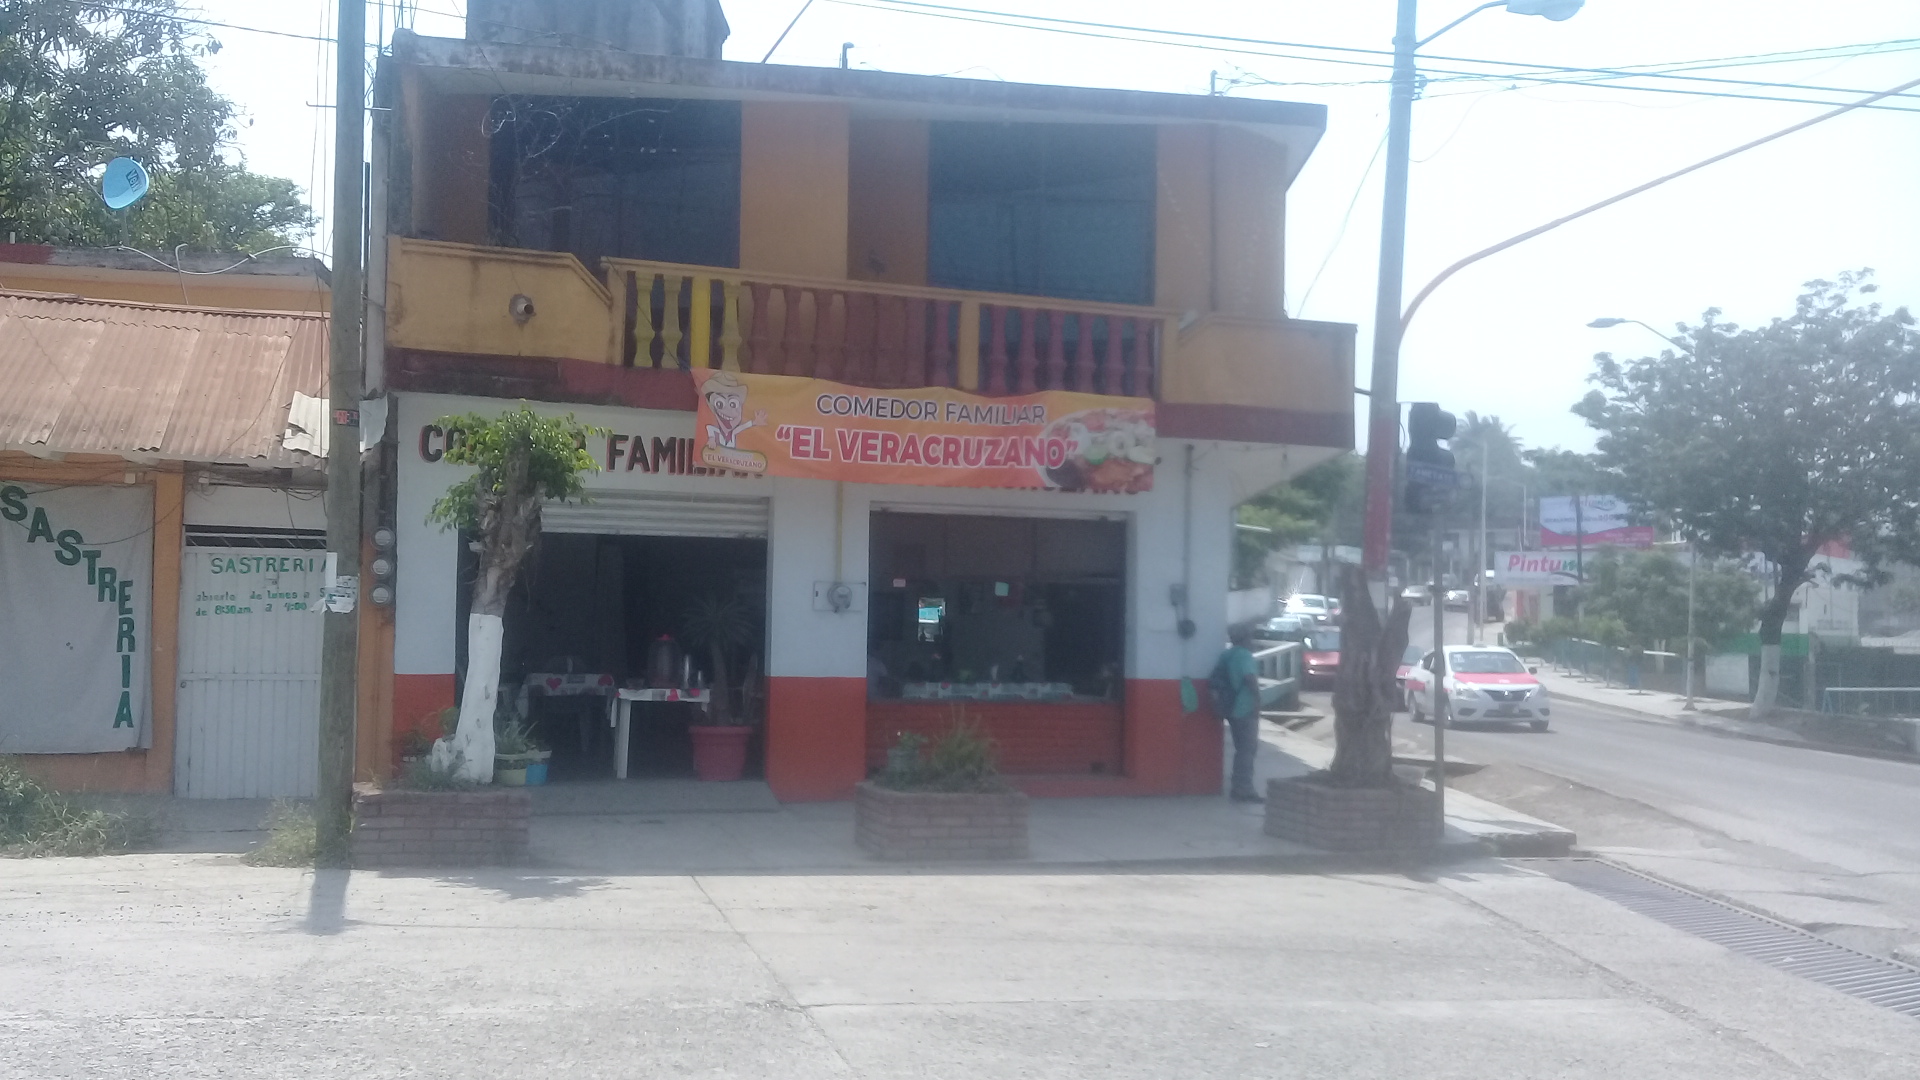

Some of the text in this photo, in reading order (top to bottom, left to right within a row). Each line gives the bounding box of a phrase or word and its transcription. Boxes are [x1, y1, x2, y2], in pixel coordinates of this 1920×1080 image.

[817, 394, 1045, 425] COMEDOR FAMILIAR
[0, 485, 136, 729] SASTRERIA
